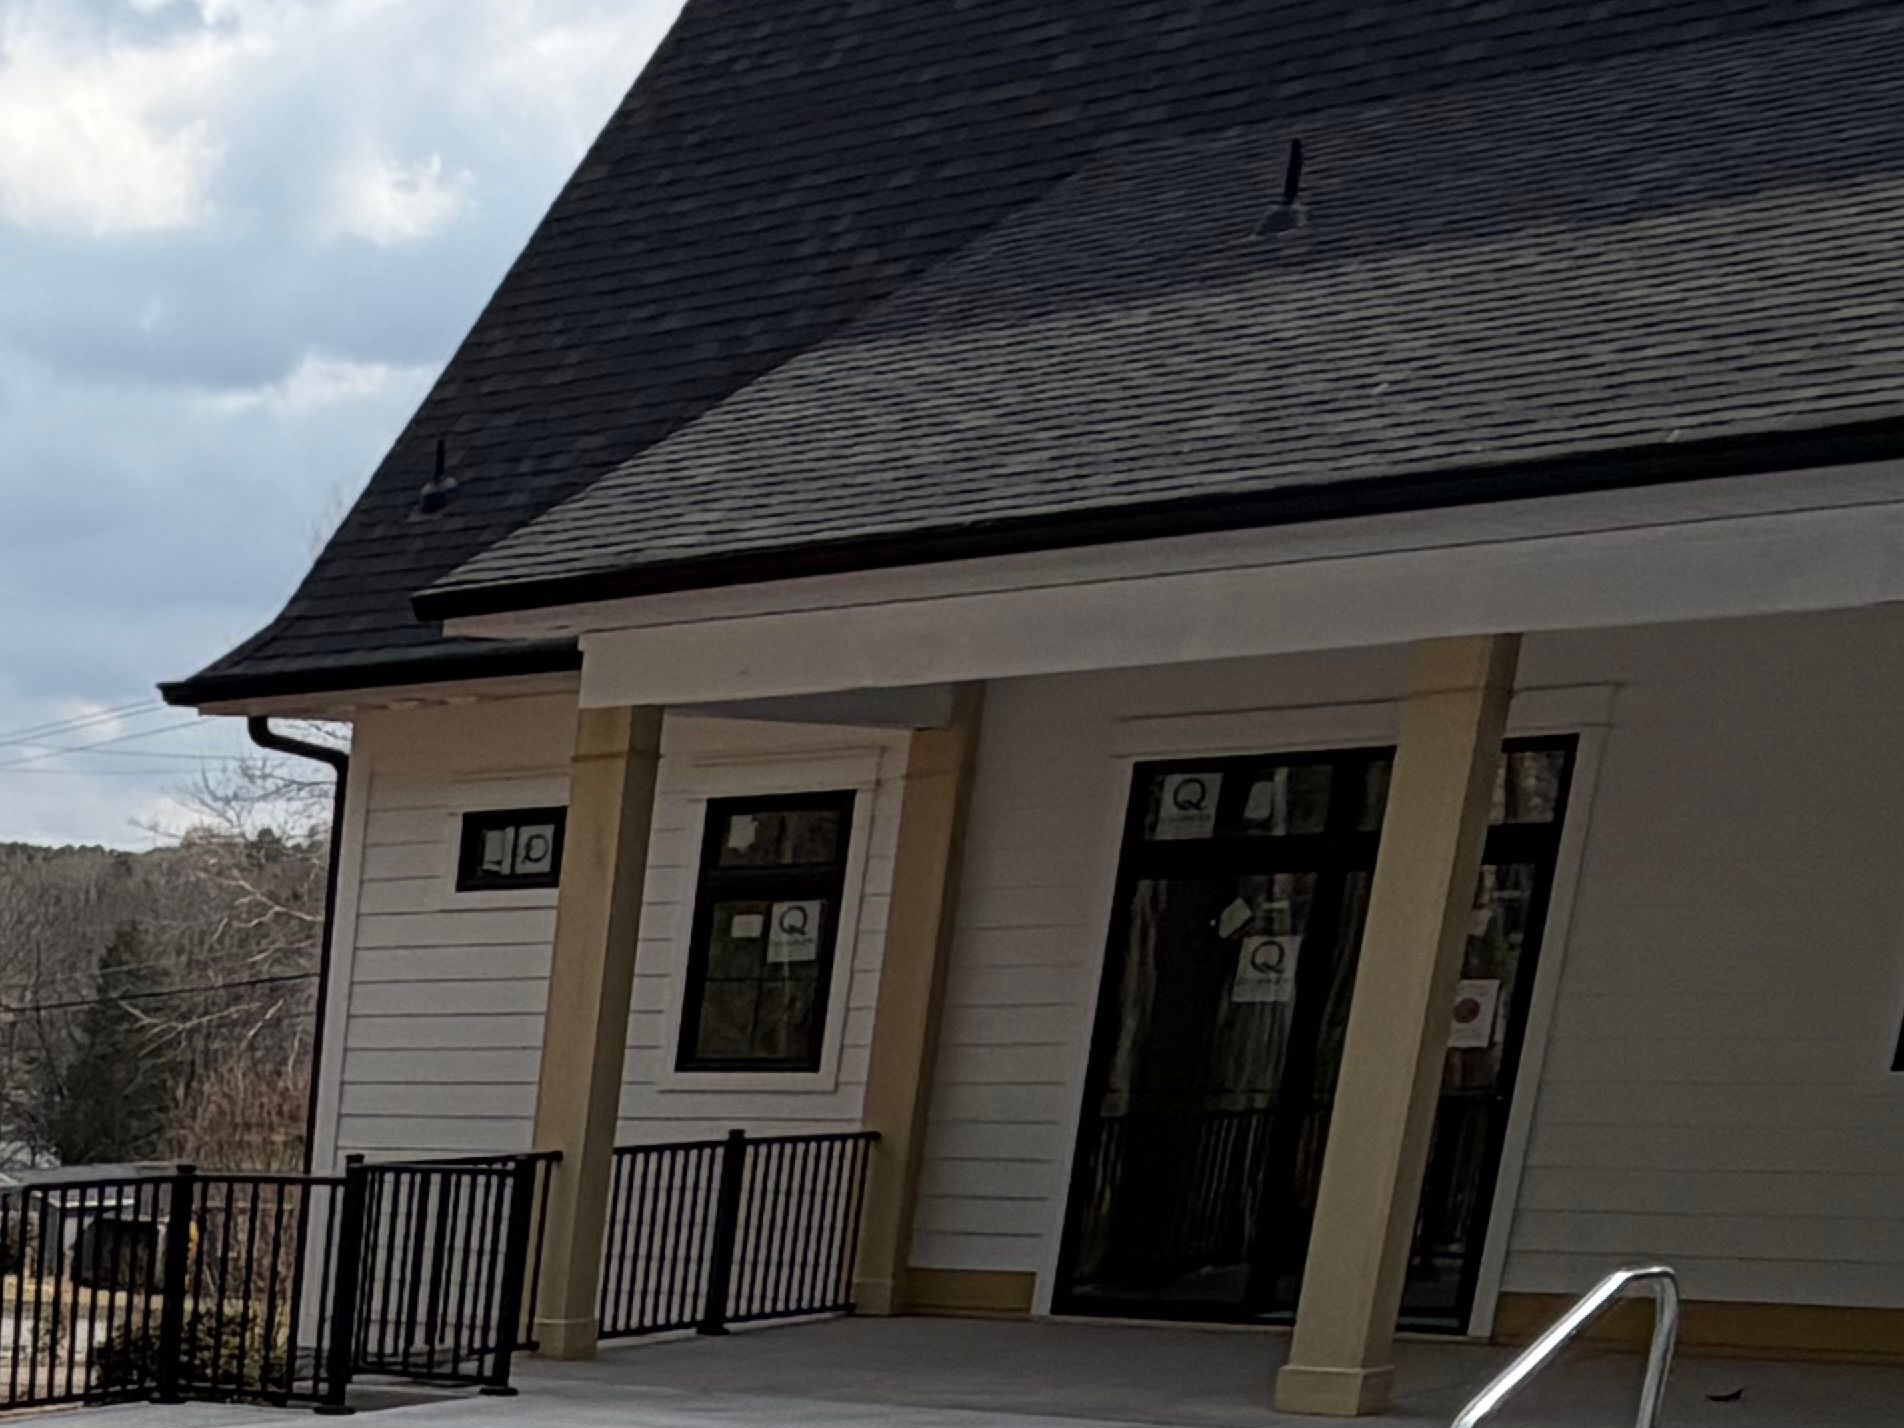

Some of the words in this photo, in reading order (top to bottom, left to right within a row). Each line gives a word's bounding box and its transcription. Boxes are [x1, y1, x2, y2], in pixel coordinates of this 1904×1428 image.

[1173, 778, 1206, 810] Q
[779, 905, 808, 935] Q
[1250, 941, 1284, 973] Q
